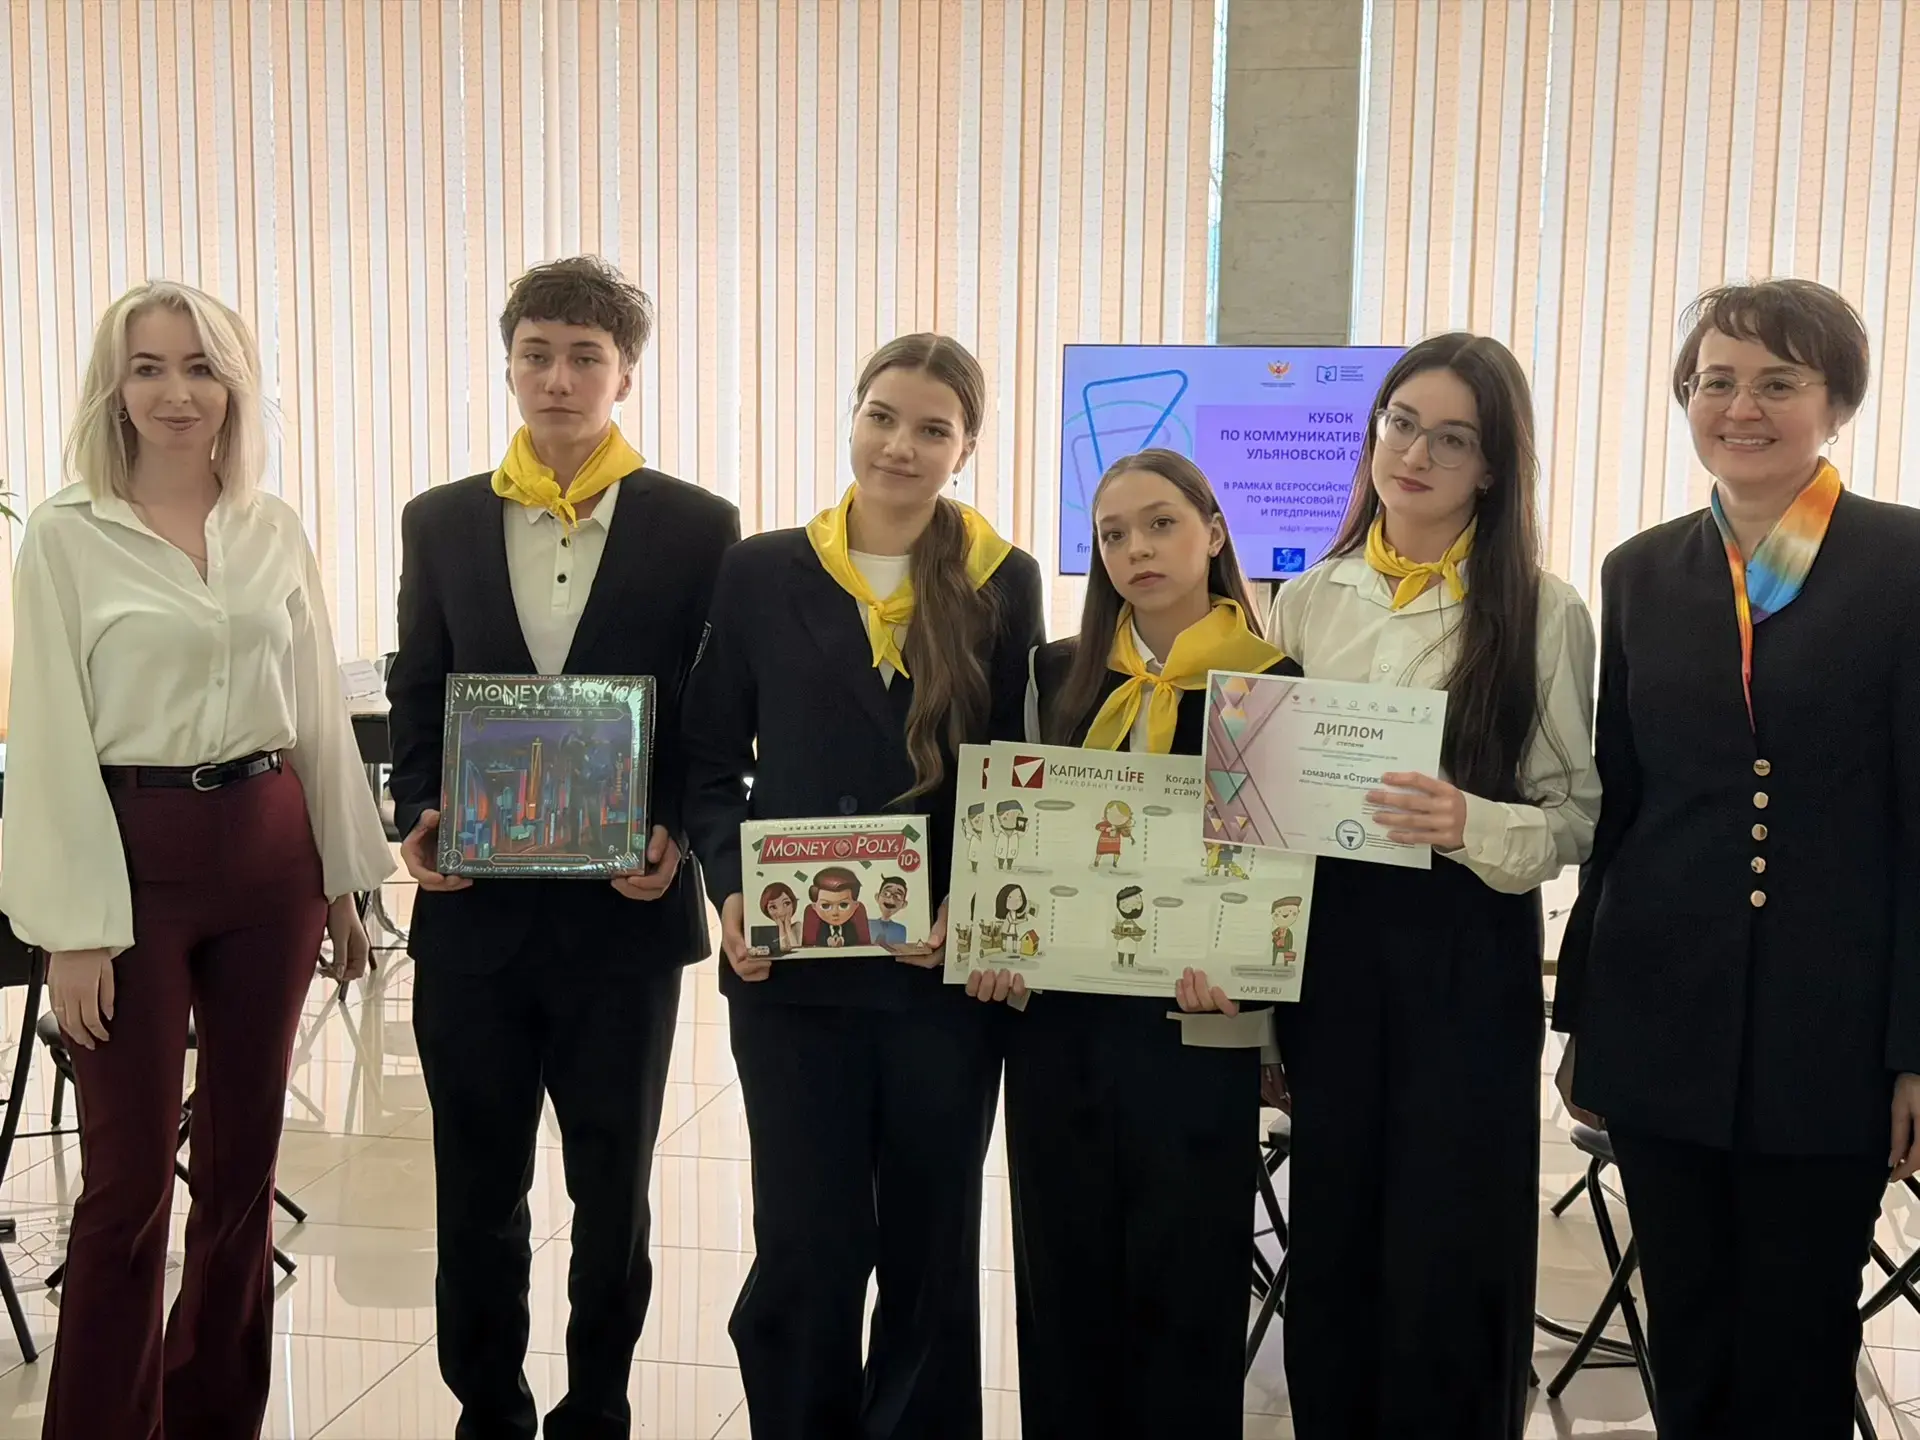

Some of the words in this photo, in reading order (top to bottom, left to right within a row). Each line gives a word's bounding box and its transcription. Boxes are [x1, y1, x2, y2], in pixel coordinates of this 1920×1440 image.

[1308, 412, 1353, 424] КУБОК
[1220, 429, 1240, 441] ПО
[1244, 430, 1364, 443] КОММУНИКАТИВ
[1246, 447, 1346, 461] УЛЬЯНОВСКОЙ
[1223, 481, 1230, 490] В
[1232, 482, 1273, 491] РАМКАХ
[1246, 494, 1262, 504] ПО
[1264, 494, 1334, 505] ФИНАНСОВОЙ
[1260, 508, 1268, 517] И
[1270, 508, 1342, 518] ПРЕДПРИНИМ
[465, 684, 545, 702] MONEY
[1313, 721, 1384, 741] ДИПЛОМ
[1049, 763, 1114, 781] КАПИТАЛ
[1302, 769, 1341, 781] команда
[1165, 773, 1195, 787] Когда
[1173, 787, 1201, 799] стану
[766, 837, 831, 858] MONEY
[900, 854, 920, 867] 10+
